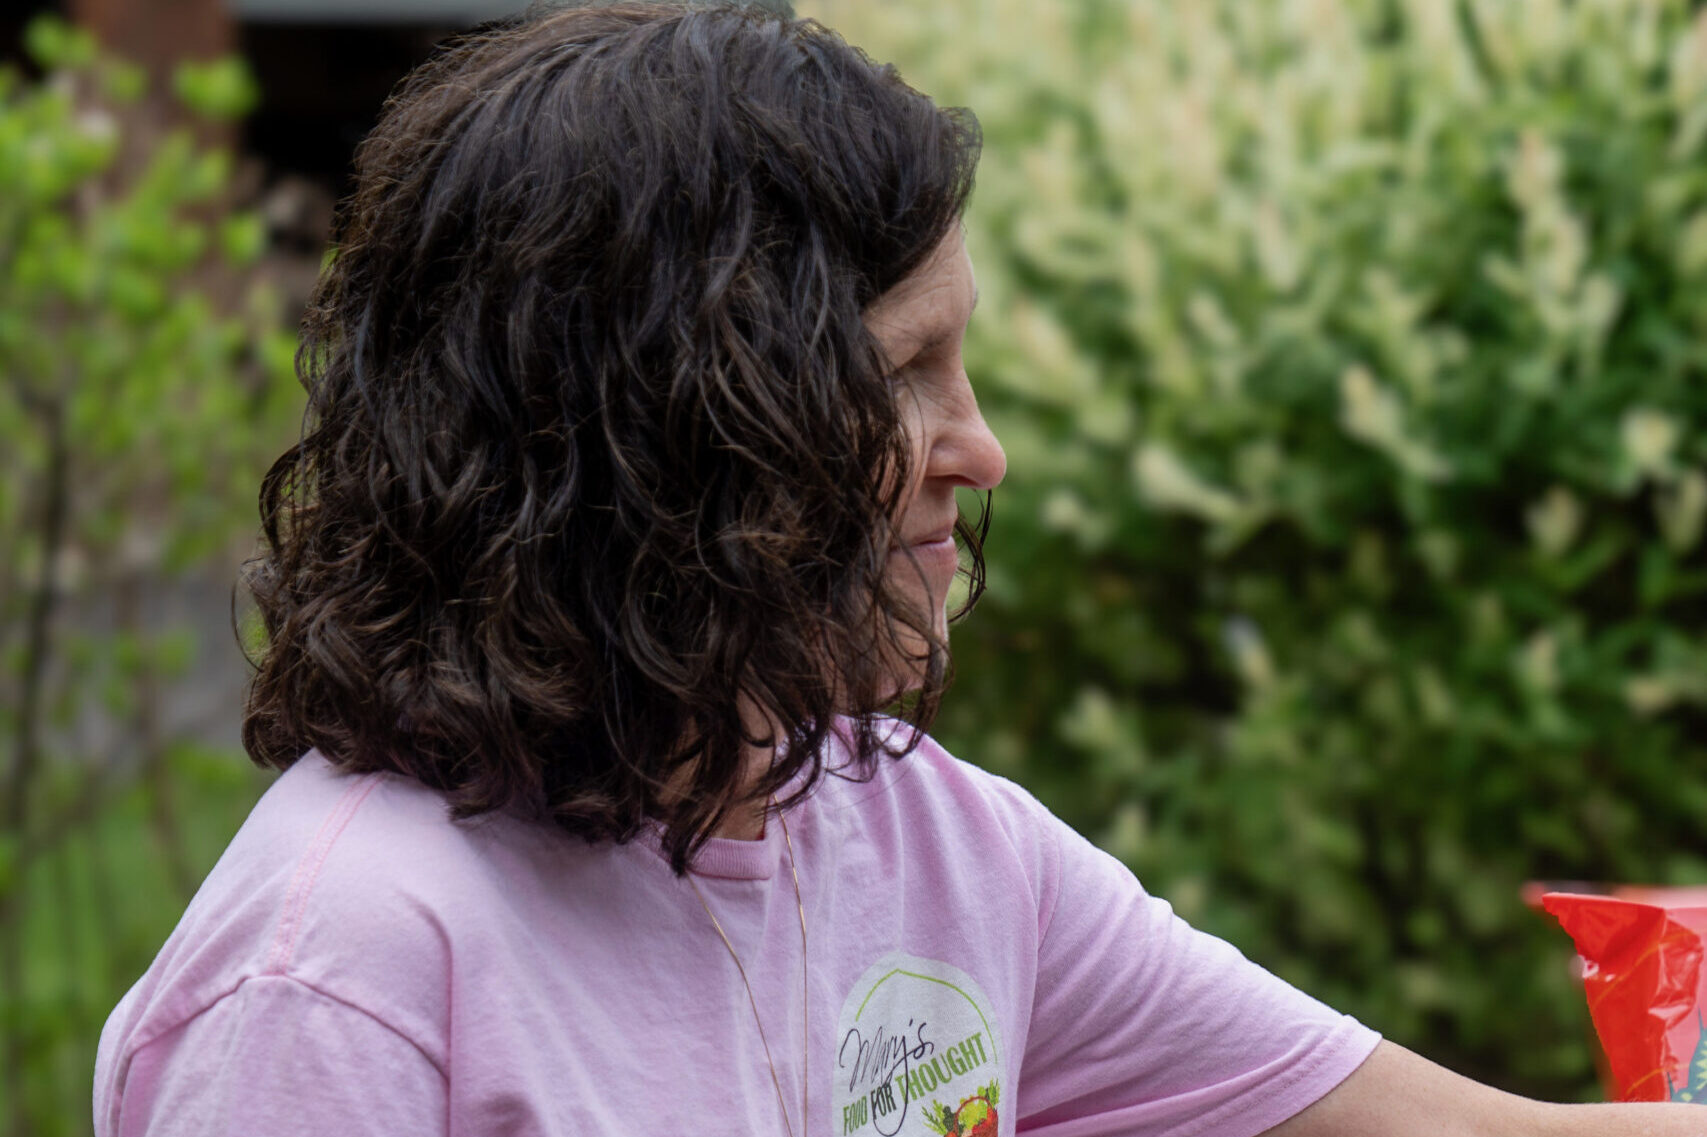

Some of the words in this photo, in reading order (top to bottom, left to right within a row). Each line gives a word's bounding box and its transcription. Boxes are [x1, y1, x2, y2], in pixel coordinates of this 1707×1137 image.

[839, 1019, 934, 1137] Mary's
[843, 1096, 868, 1136] FOOD
[871, 1084, 897, 1120] FOR
[895, 1032, 987, 1104] THOUGHT
